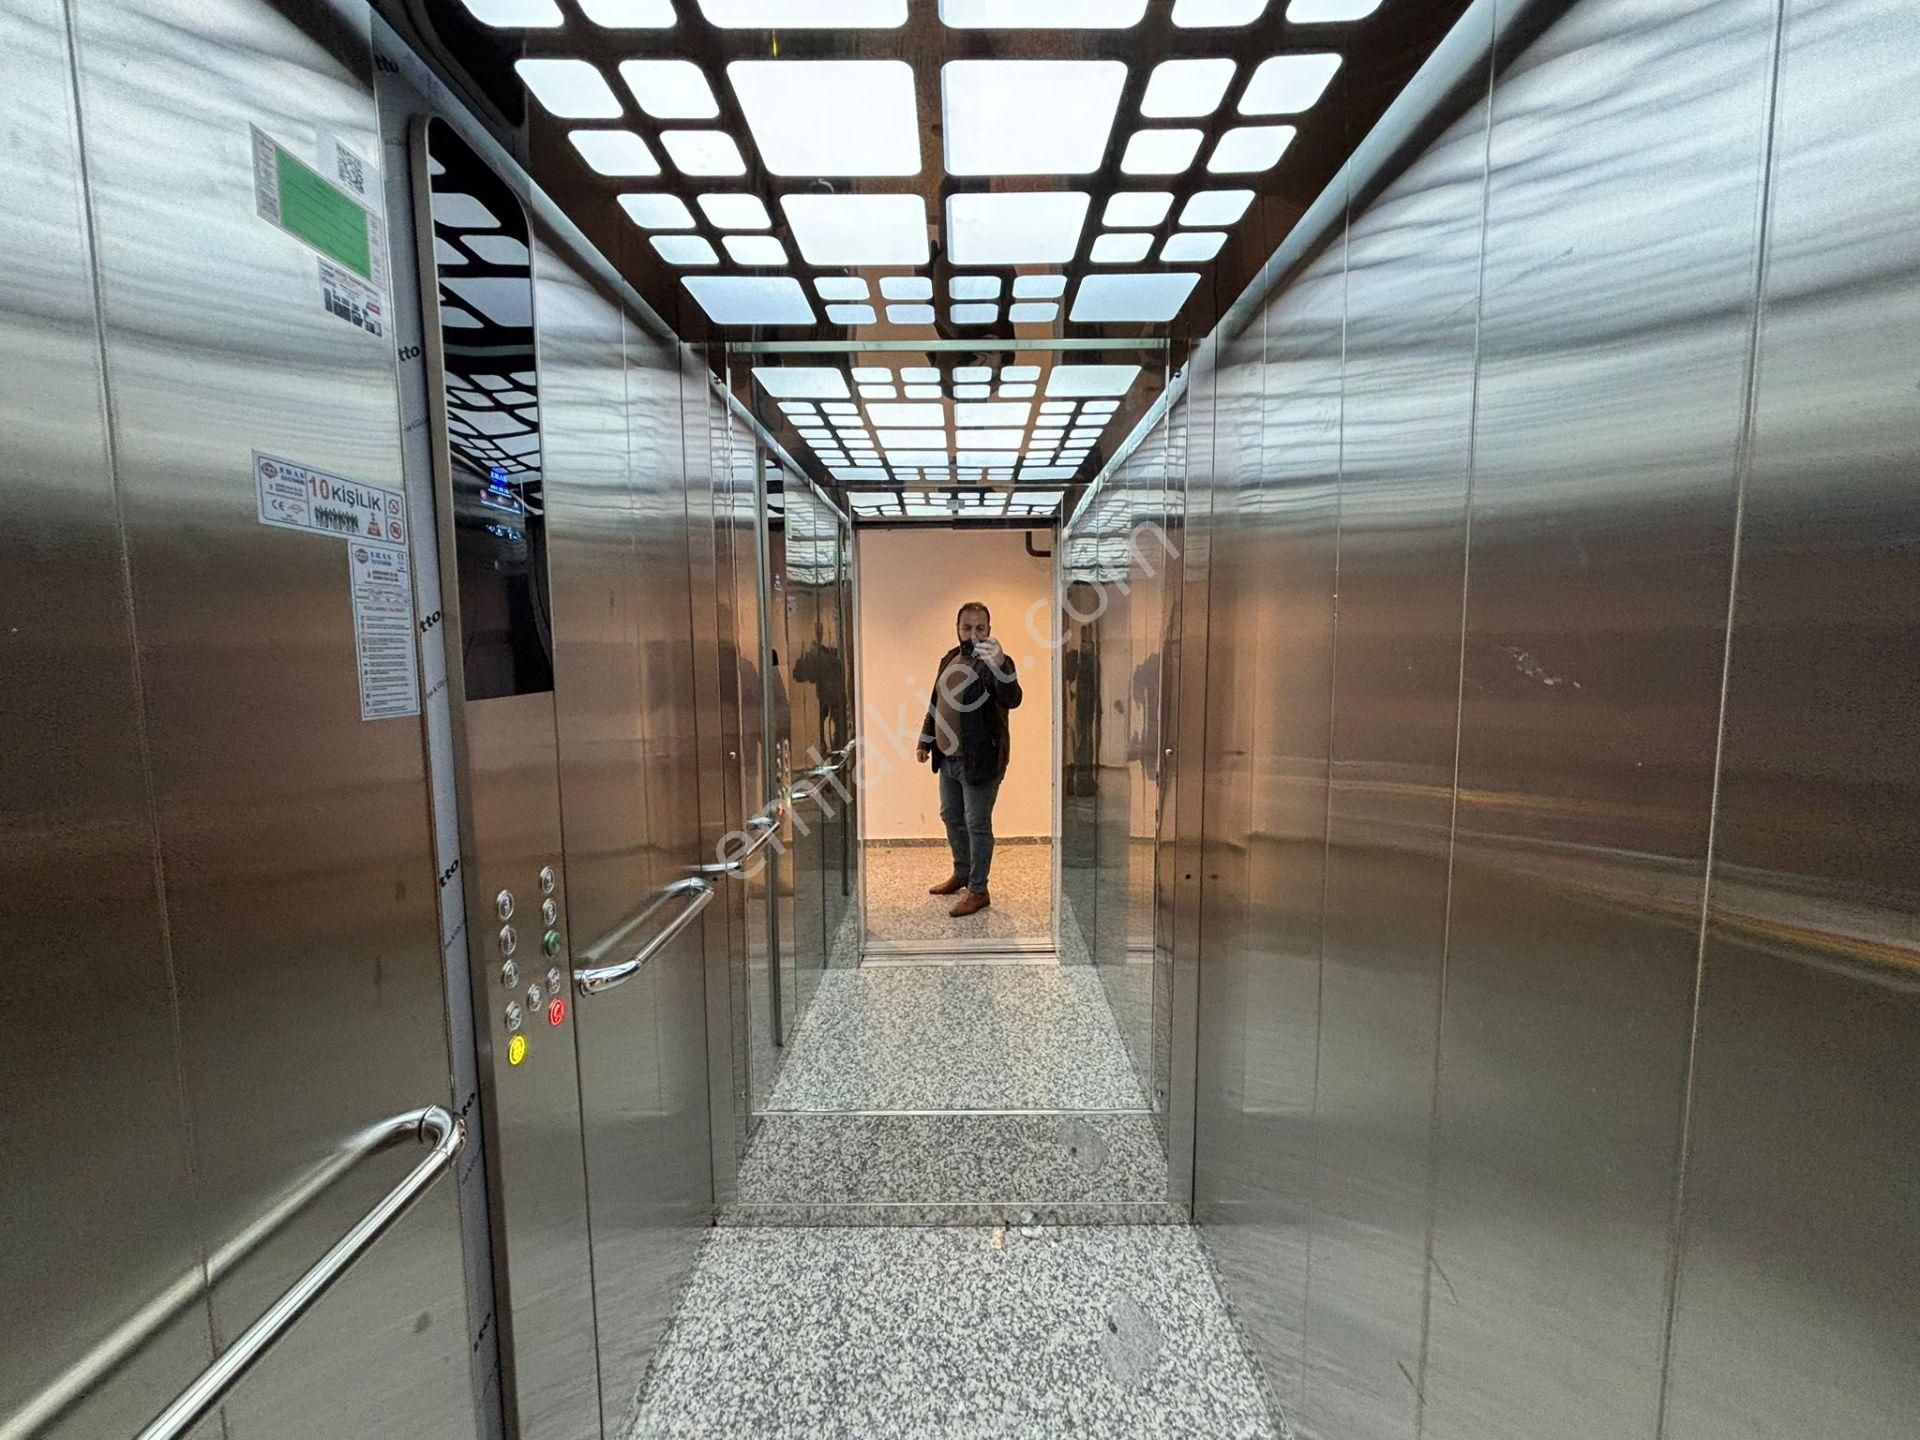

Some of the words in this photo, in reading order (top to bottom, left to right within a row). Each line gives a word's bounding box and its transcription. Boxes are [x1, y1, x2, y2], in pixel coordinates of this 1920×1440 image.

[309, 476, 329, 500] 10
[332, 485, 382, 512] KİŞİLİK
[420, 610, 441, 633] tto
